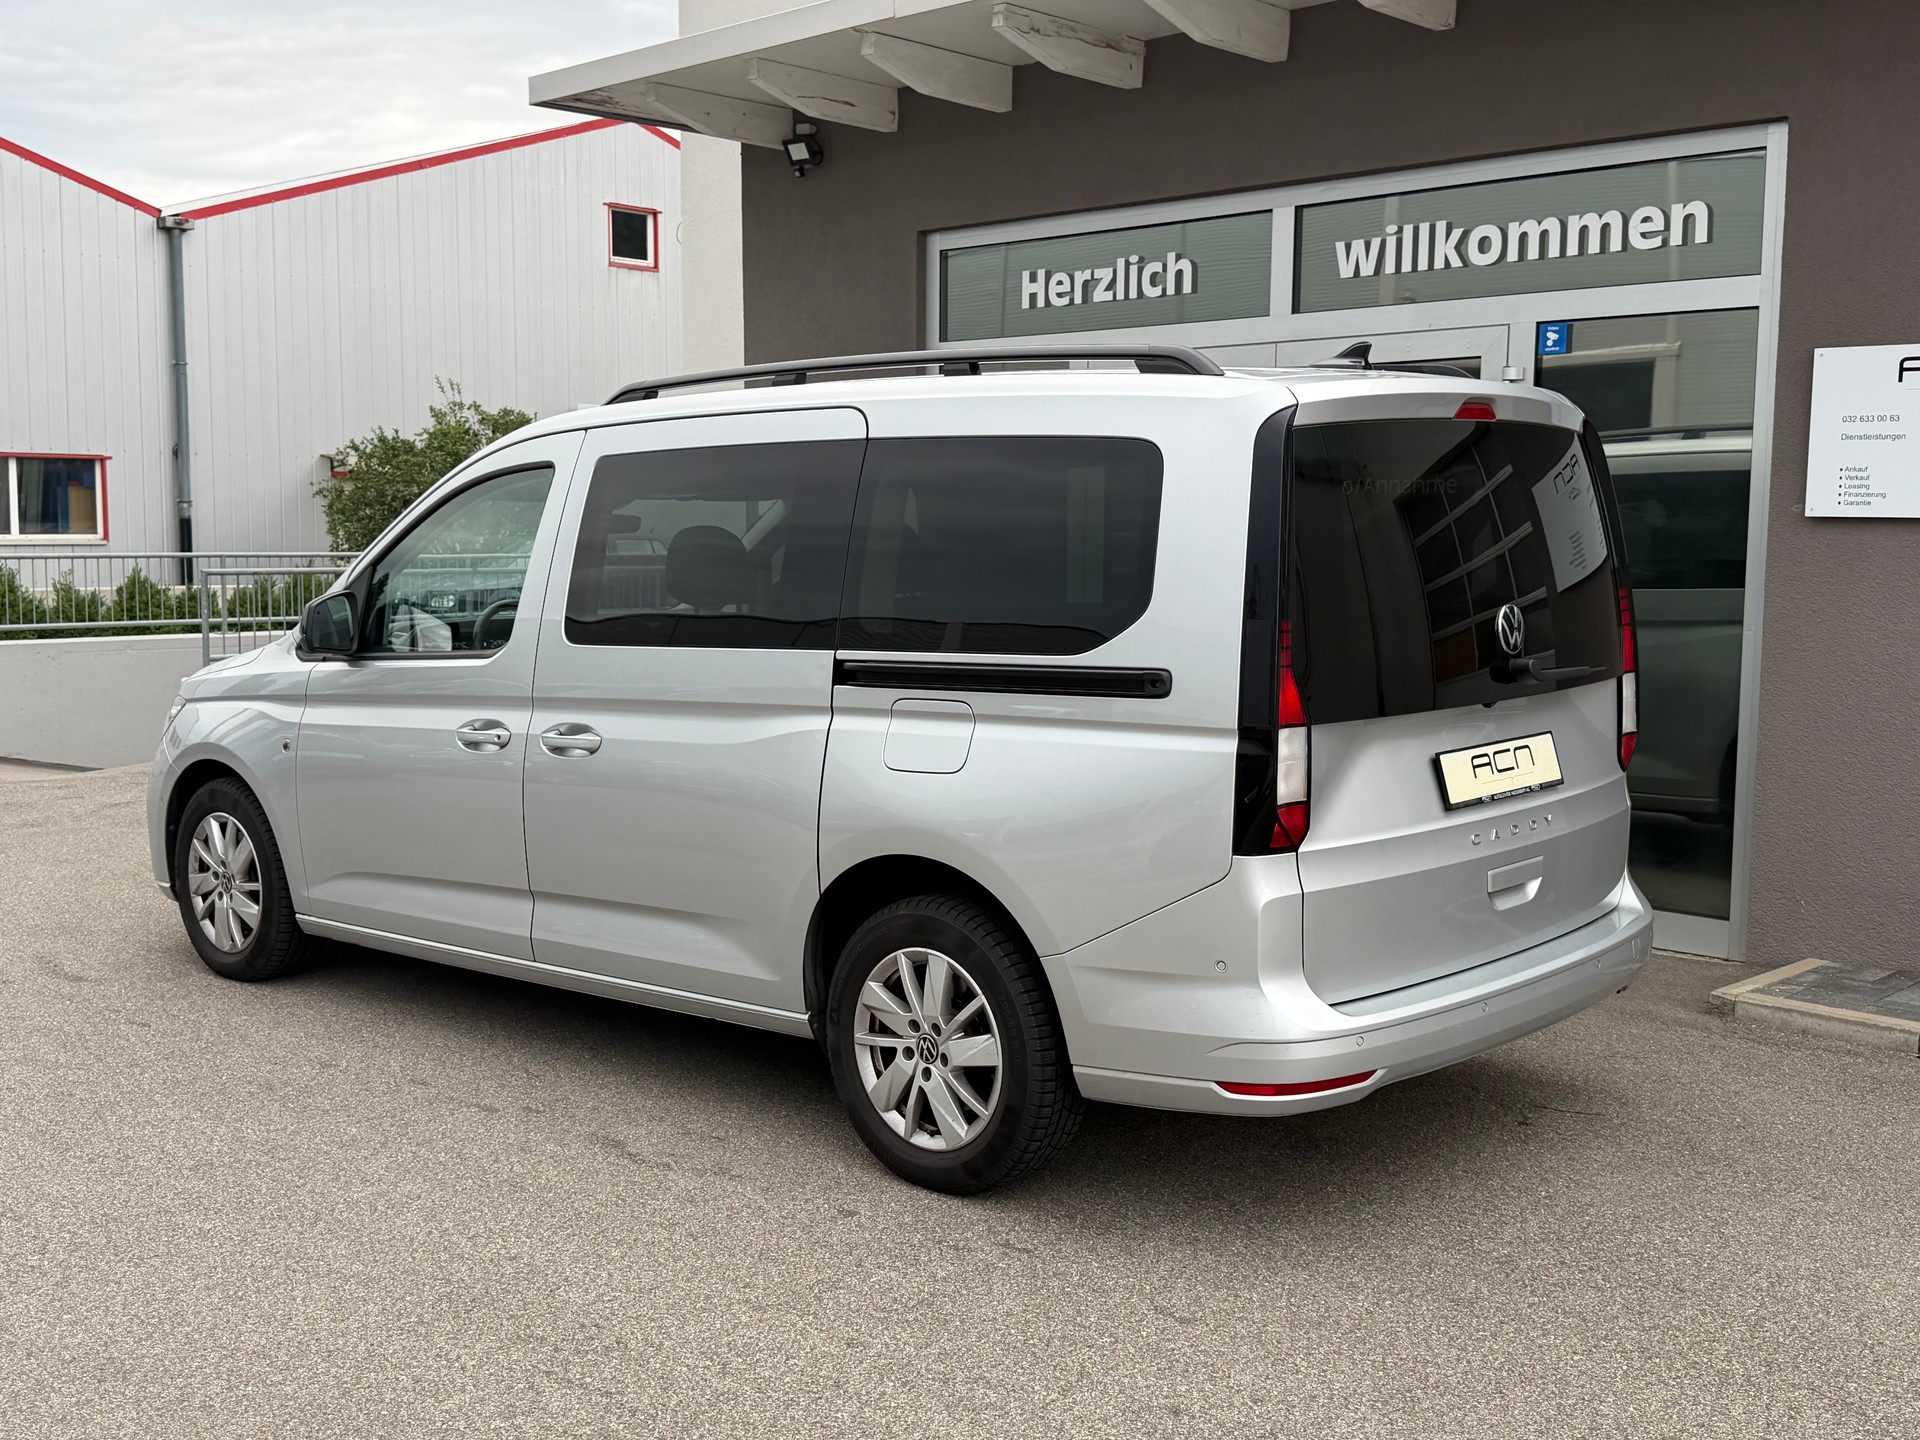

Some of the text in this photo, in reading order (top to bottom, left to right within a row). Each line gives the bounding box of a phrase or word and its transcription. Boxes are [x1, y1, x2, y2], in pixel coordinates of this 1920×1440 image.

[1020, 200, 1711, 310] Herzlich willkommen
[1842, 414, 1900, 423] 032 633 00 63
[1841, 433, 1906, 442] Dienstleistungen
[1844, 482, 1870, 490] Leasing
[1843, 491, 1887, 499] Finanzierung
[1843, 499, 1872, 507] Garantie
[1471, 744, 1535, 779] ACN
[1470, 813, 1552, 846] CADDY
